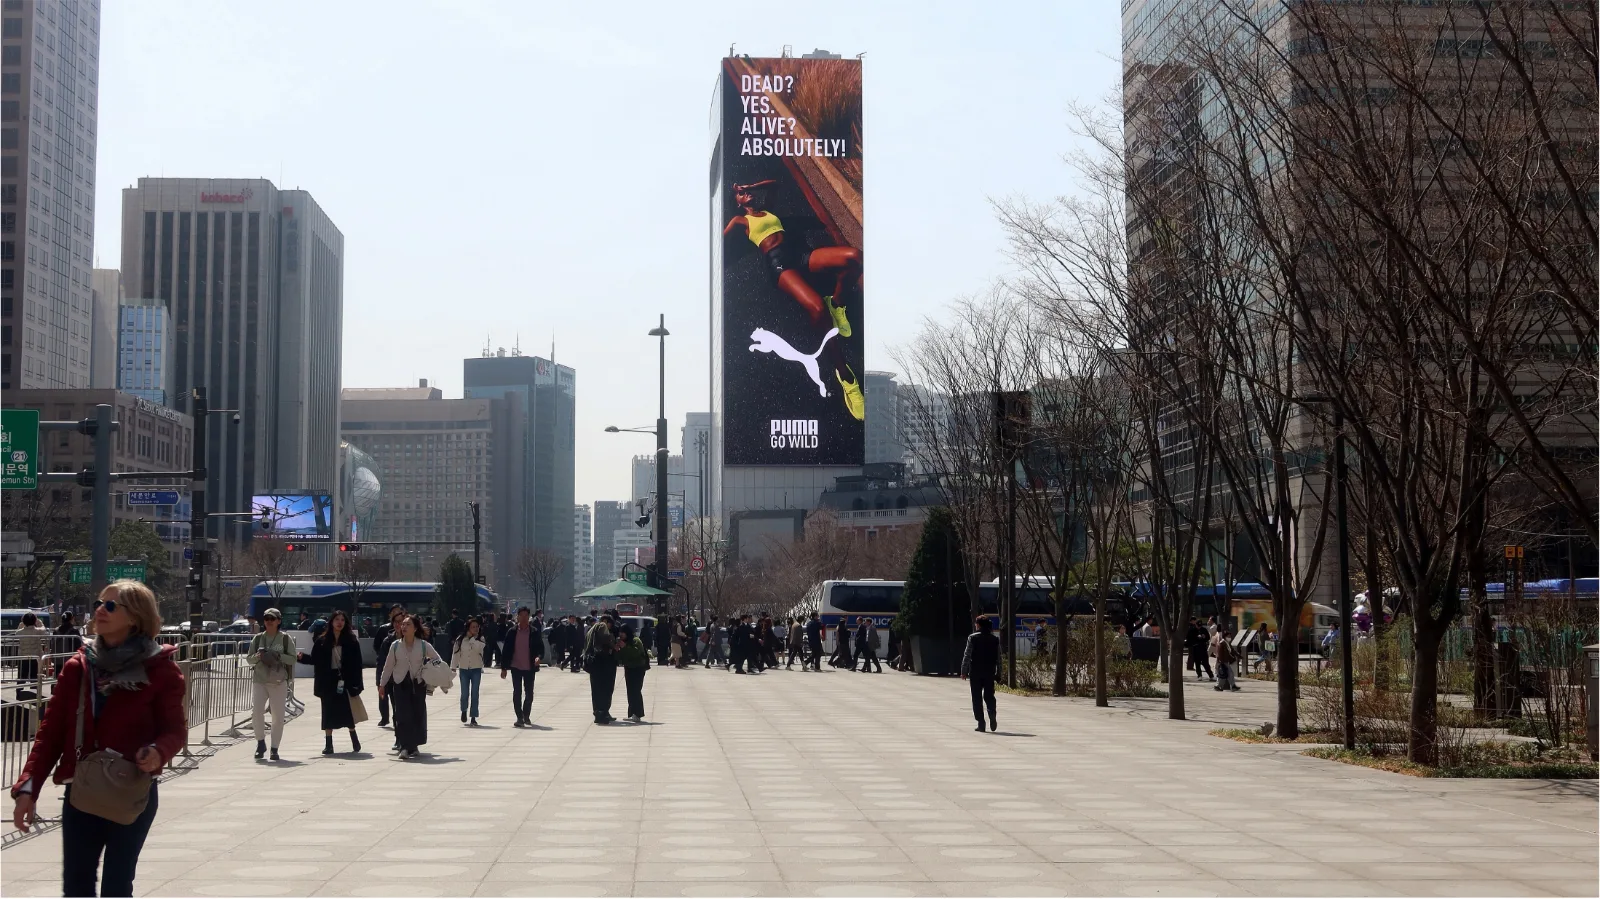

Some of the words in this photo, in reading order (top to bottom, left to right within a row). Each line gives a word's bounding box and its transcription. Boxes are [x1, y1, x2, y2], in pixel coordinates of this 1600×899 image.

[741, 75, 794, 93] DEAD?
[741, 96, 775, 114] YES.
[741, 117, 796, 135] ALIVE?
[741, 138, 846, 157] ABSOLUTELY!
[770, 419, 818, 435] PUMA
[770, 435, 786, 448] GO
[788, 435, 818, 448] WILD
[15, 452, 25, 461] 21
[22, 476, 35, 485] Stn
[693, 560, 701, 568] 50
